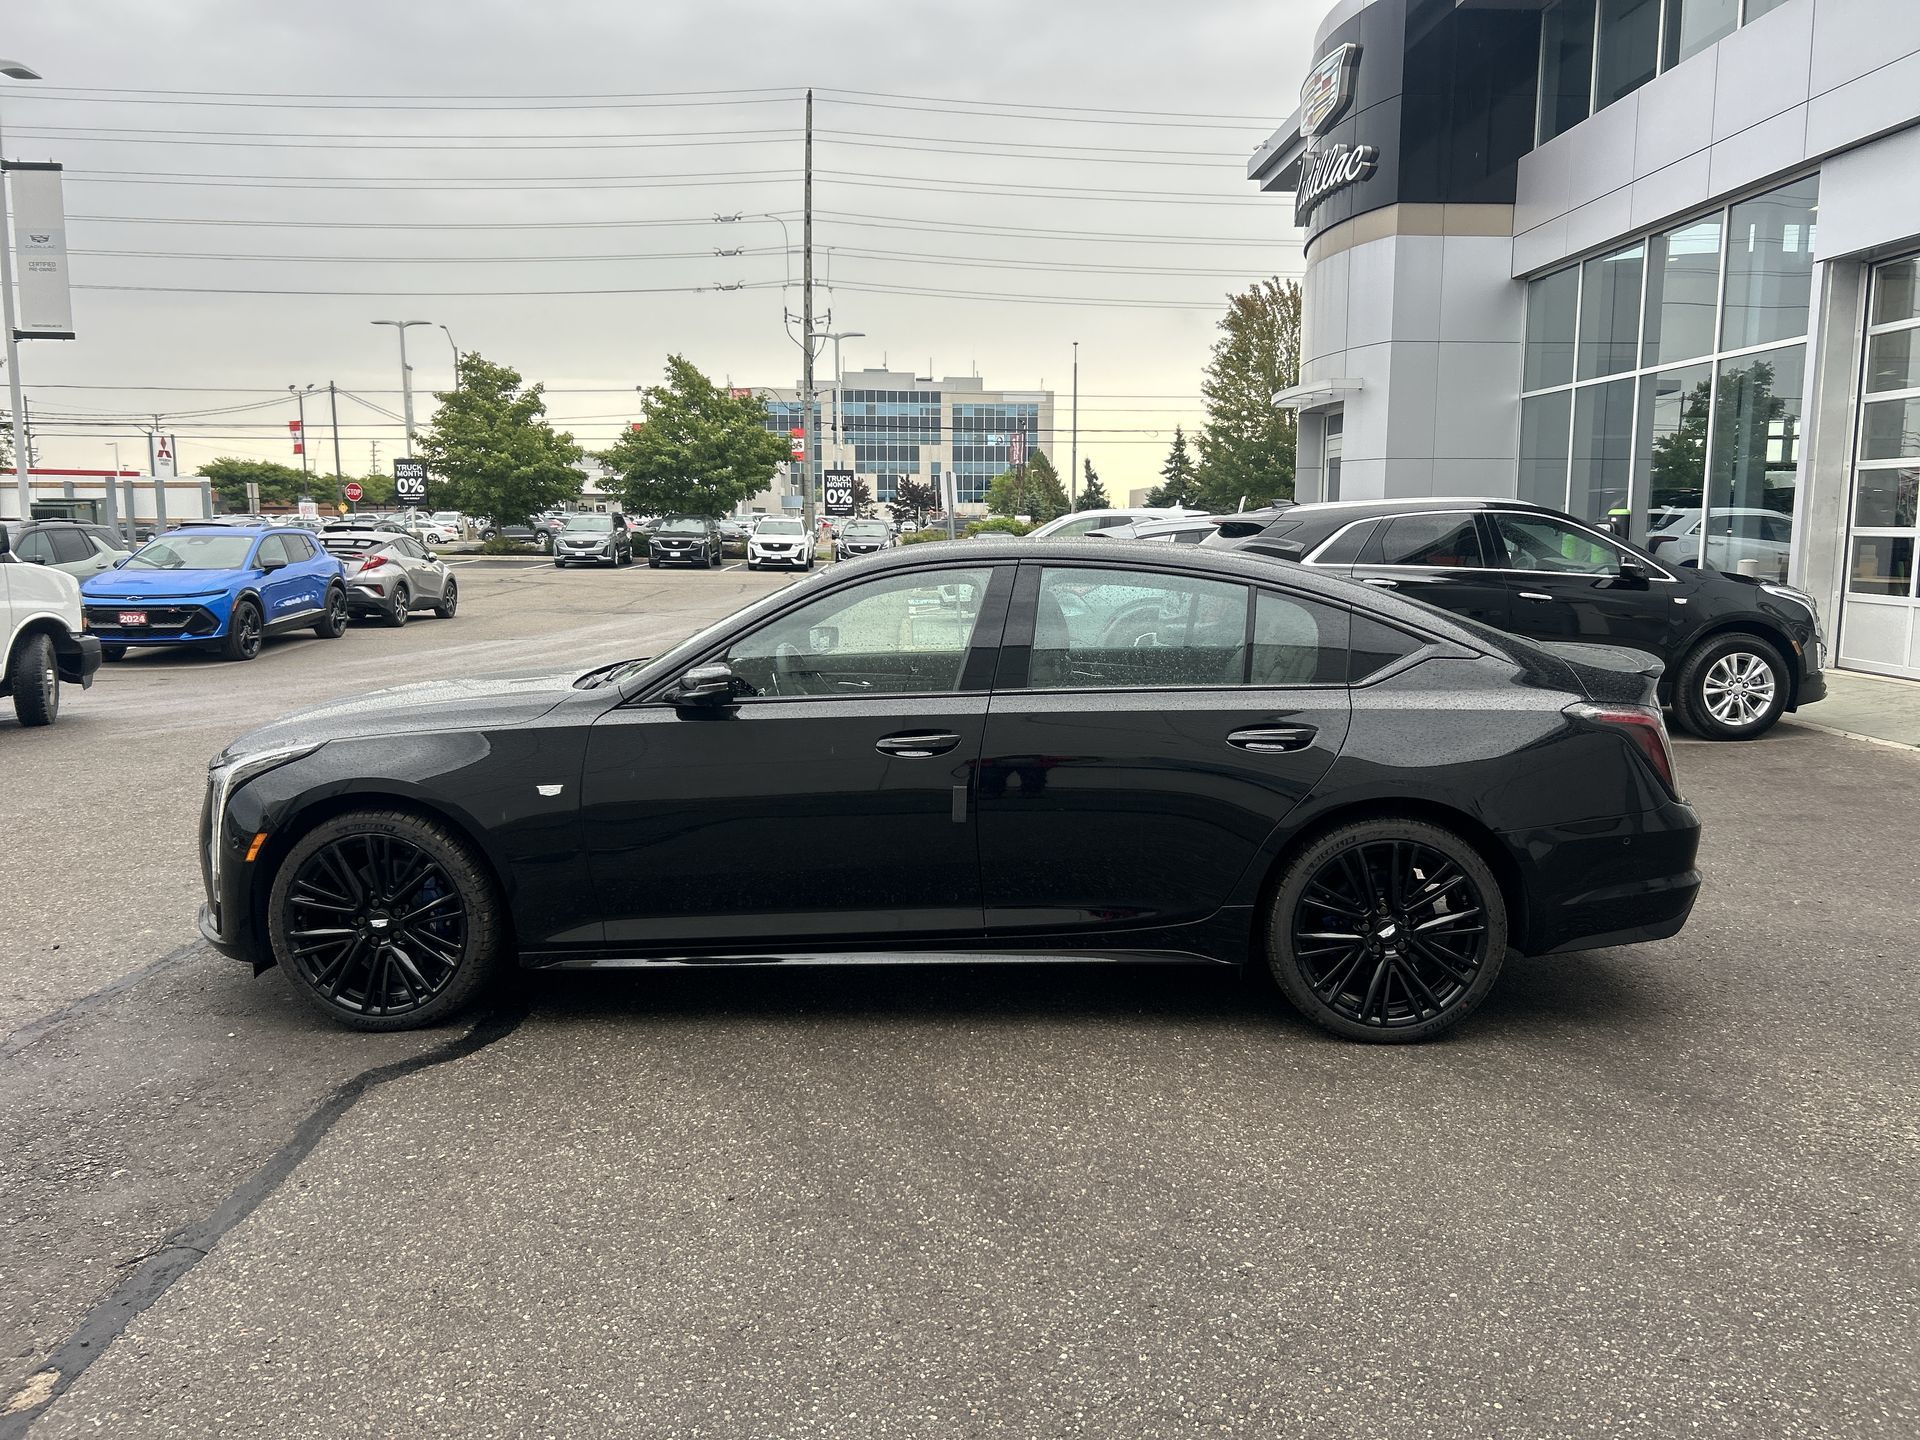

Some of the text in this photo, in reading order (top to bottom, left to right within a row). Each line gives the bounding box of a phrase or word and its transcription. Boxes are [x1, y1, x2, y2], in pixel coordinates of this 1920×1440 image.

[1297, 143, 1368, 213] Cadillac
[397, 478, 425, 493] 0%
[826, 488, 853, 504] 0%
[120, 615, 145, 623] 2024
